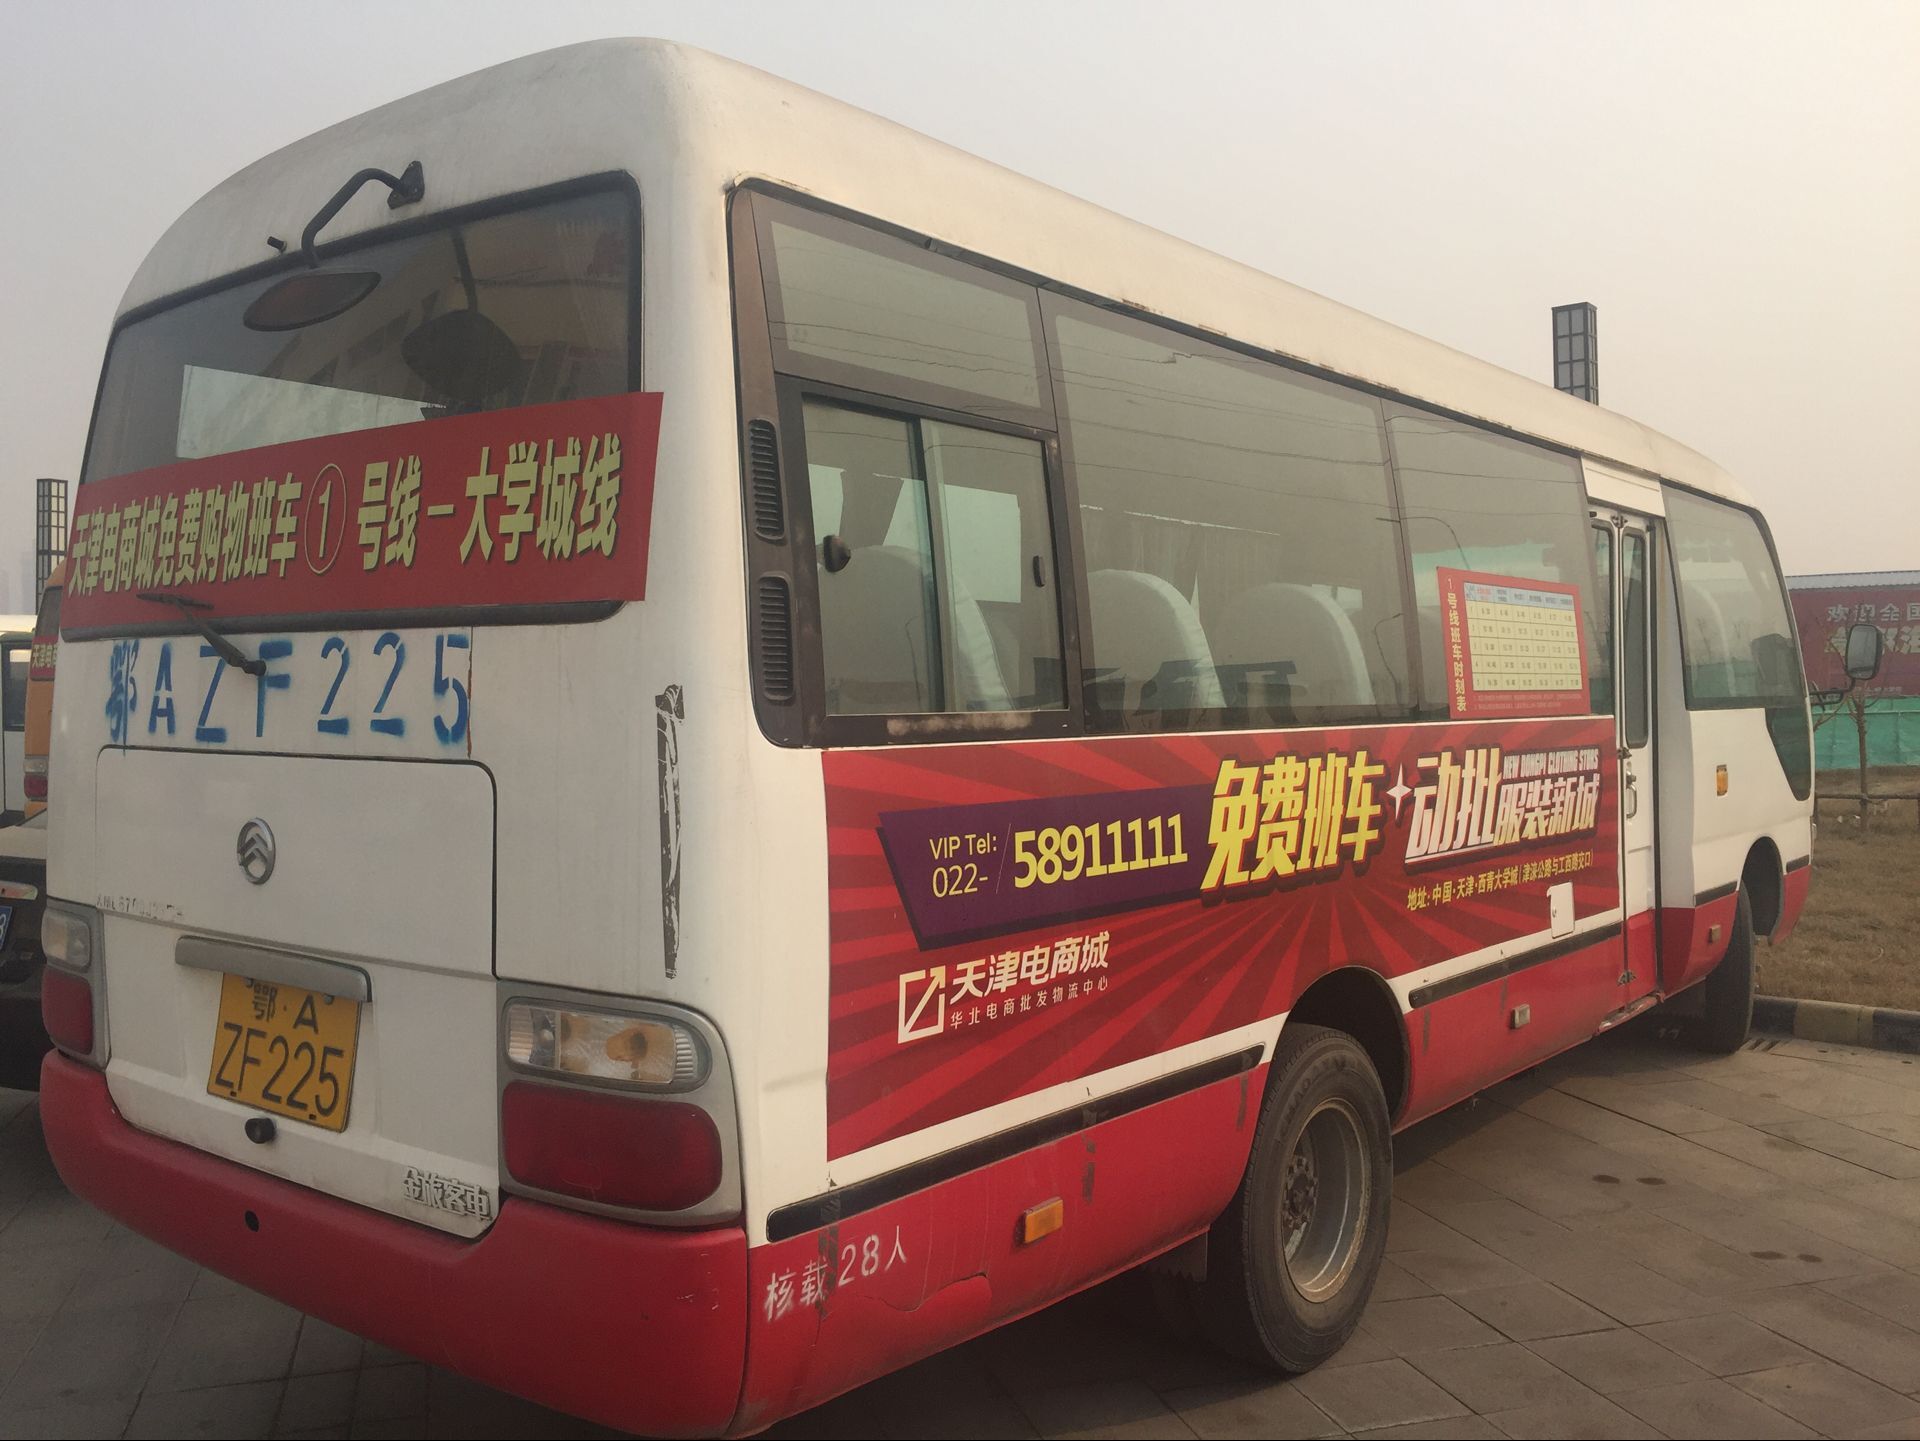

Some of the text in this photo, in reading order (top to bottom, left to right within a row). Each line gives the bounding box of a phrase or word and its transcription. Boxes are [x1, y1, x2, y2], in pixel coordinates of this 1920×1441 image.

[1200, 750, 1385, 890] 免费班车
[1494, 773, 1600, 845] 服装新城
[929, 832, 997, 860] VIP Tel:
[932, 862, 988, 898] 022-
[1014, 813, 1188, 888] 58911111
[950, 930, 1110, 1004] 天津电商城
[950, 975, 1109, 1029] 华北电商批发物流中心
[214, 1020, 346, 1118] ZF225
